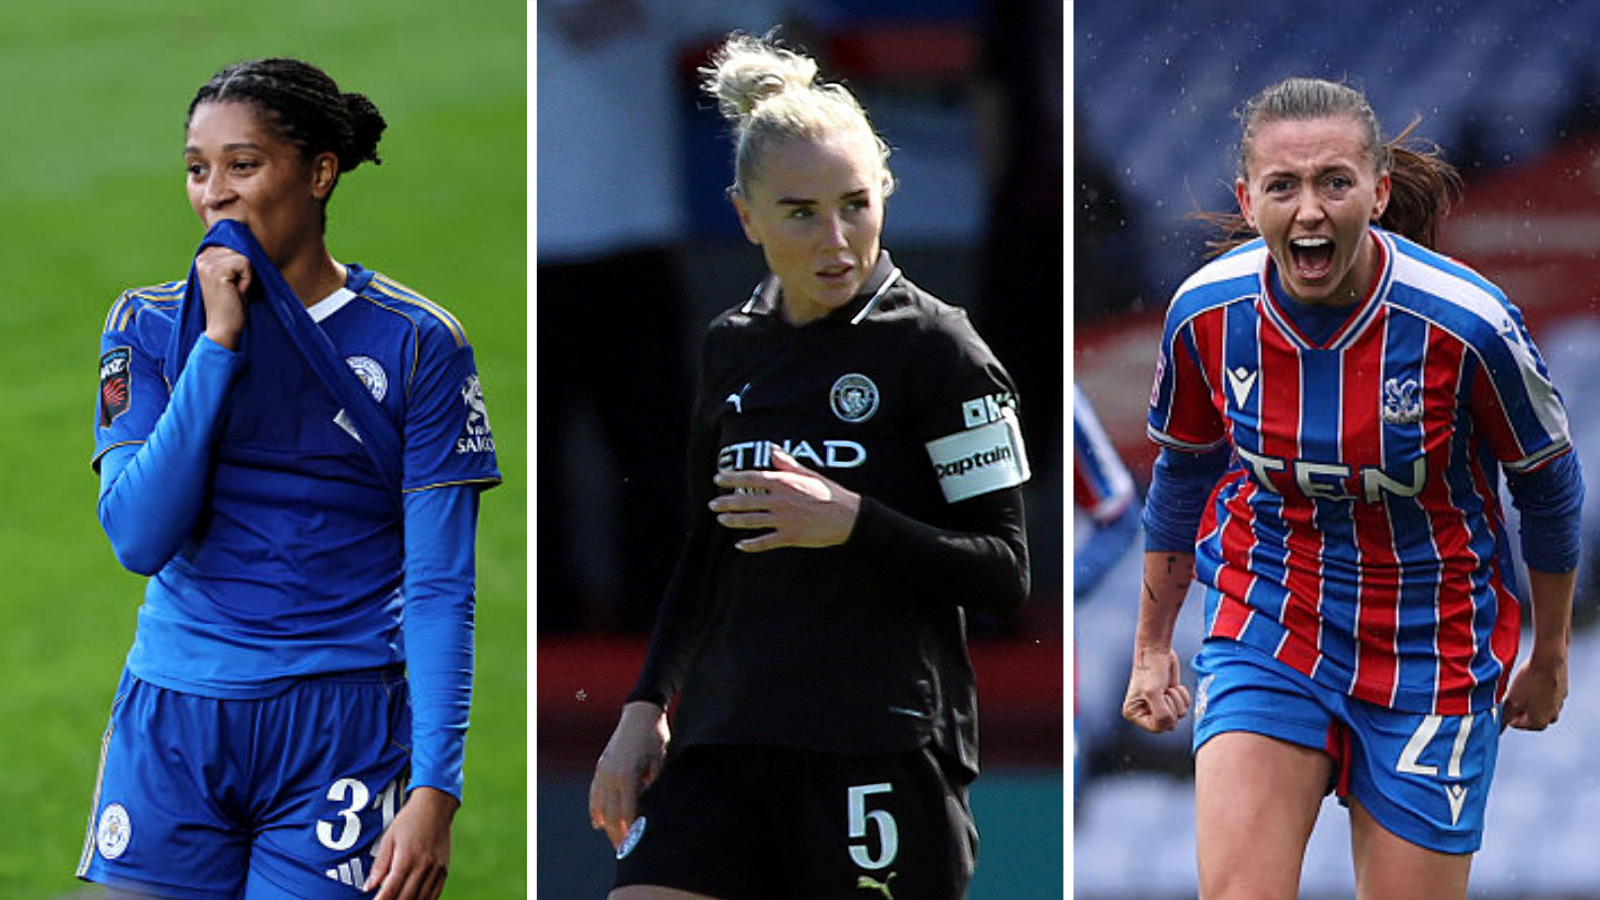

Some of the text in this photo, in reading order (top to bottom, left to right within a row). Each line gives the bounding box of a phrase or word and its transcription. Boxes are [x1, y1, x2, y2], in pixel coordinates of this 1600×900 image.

[1237, 446, 1427, 503] TEN
[316, 778, 397, 857] 31
[848, 783, 898, 870] 5
